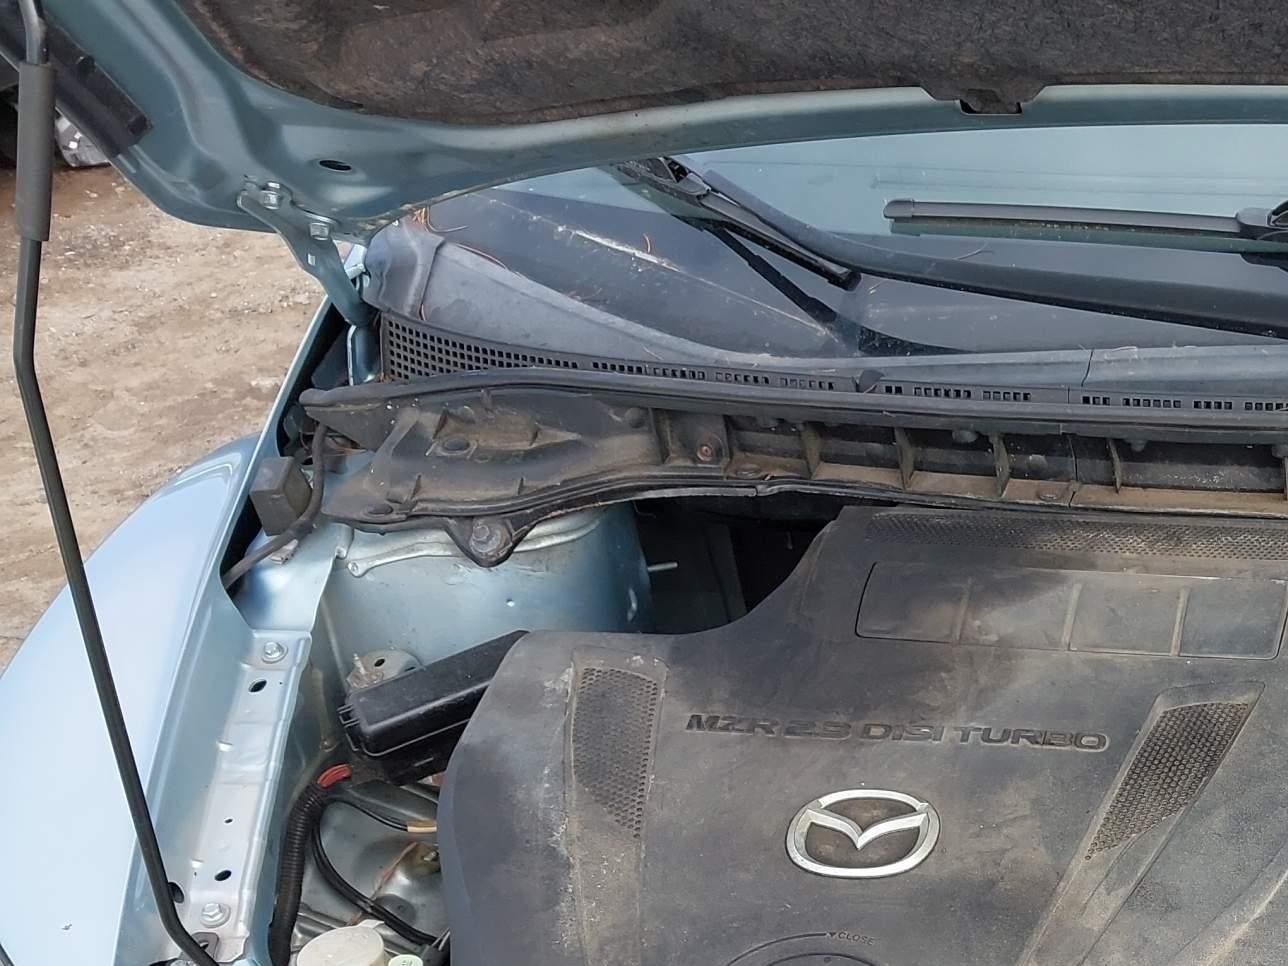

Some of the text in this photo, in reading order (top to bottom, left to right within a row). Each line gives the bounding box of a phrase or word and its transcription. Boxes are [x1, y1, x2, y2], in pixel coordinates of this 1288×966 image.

[686, 714, 780, 735] MZR
[861, 724, 946, 744] DISI
[955, 727, 1110, 753] TURBO
[838, 931, 875, 946] CLOSE
